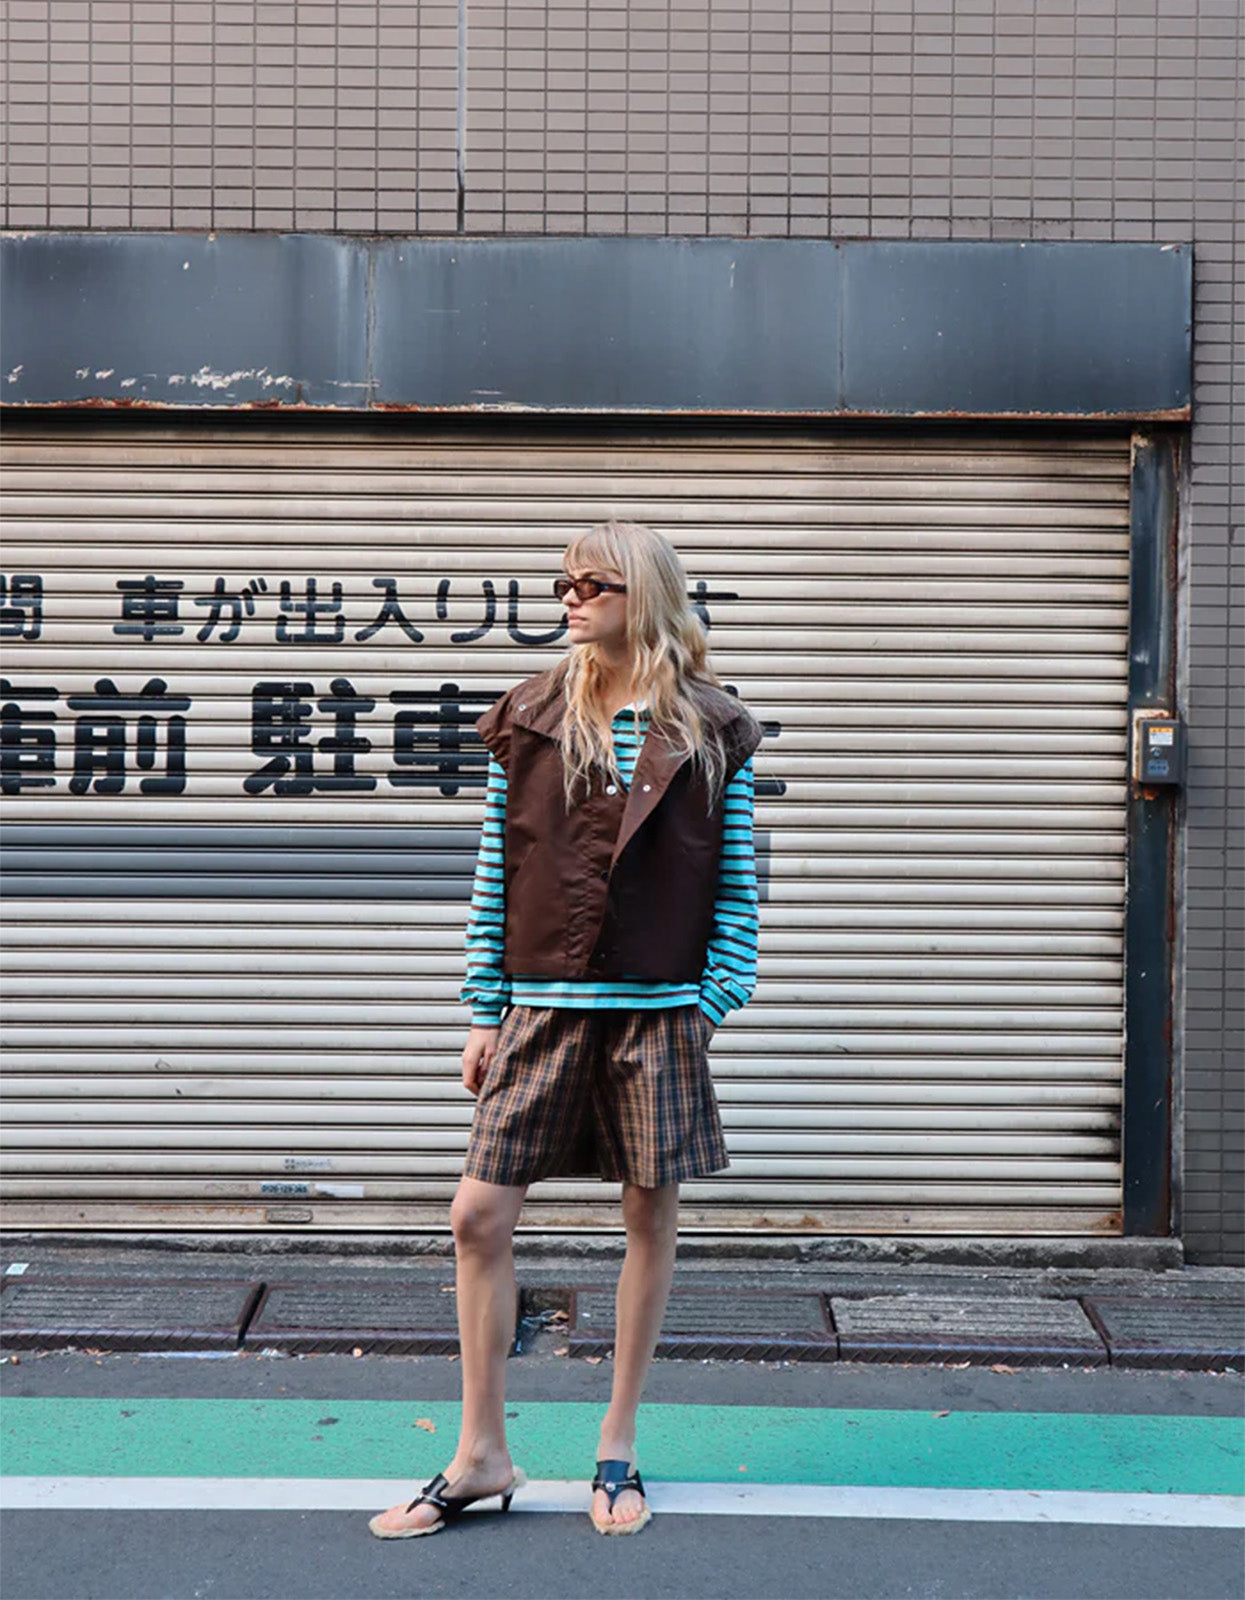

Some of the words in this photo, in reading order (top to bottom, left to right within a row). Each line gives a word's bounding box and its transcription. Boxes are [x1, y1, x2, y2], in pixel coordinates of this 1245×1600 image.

[113, 575, 739, 644] 車が出入りし
